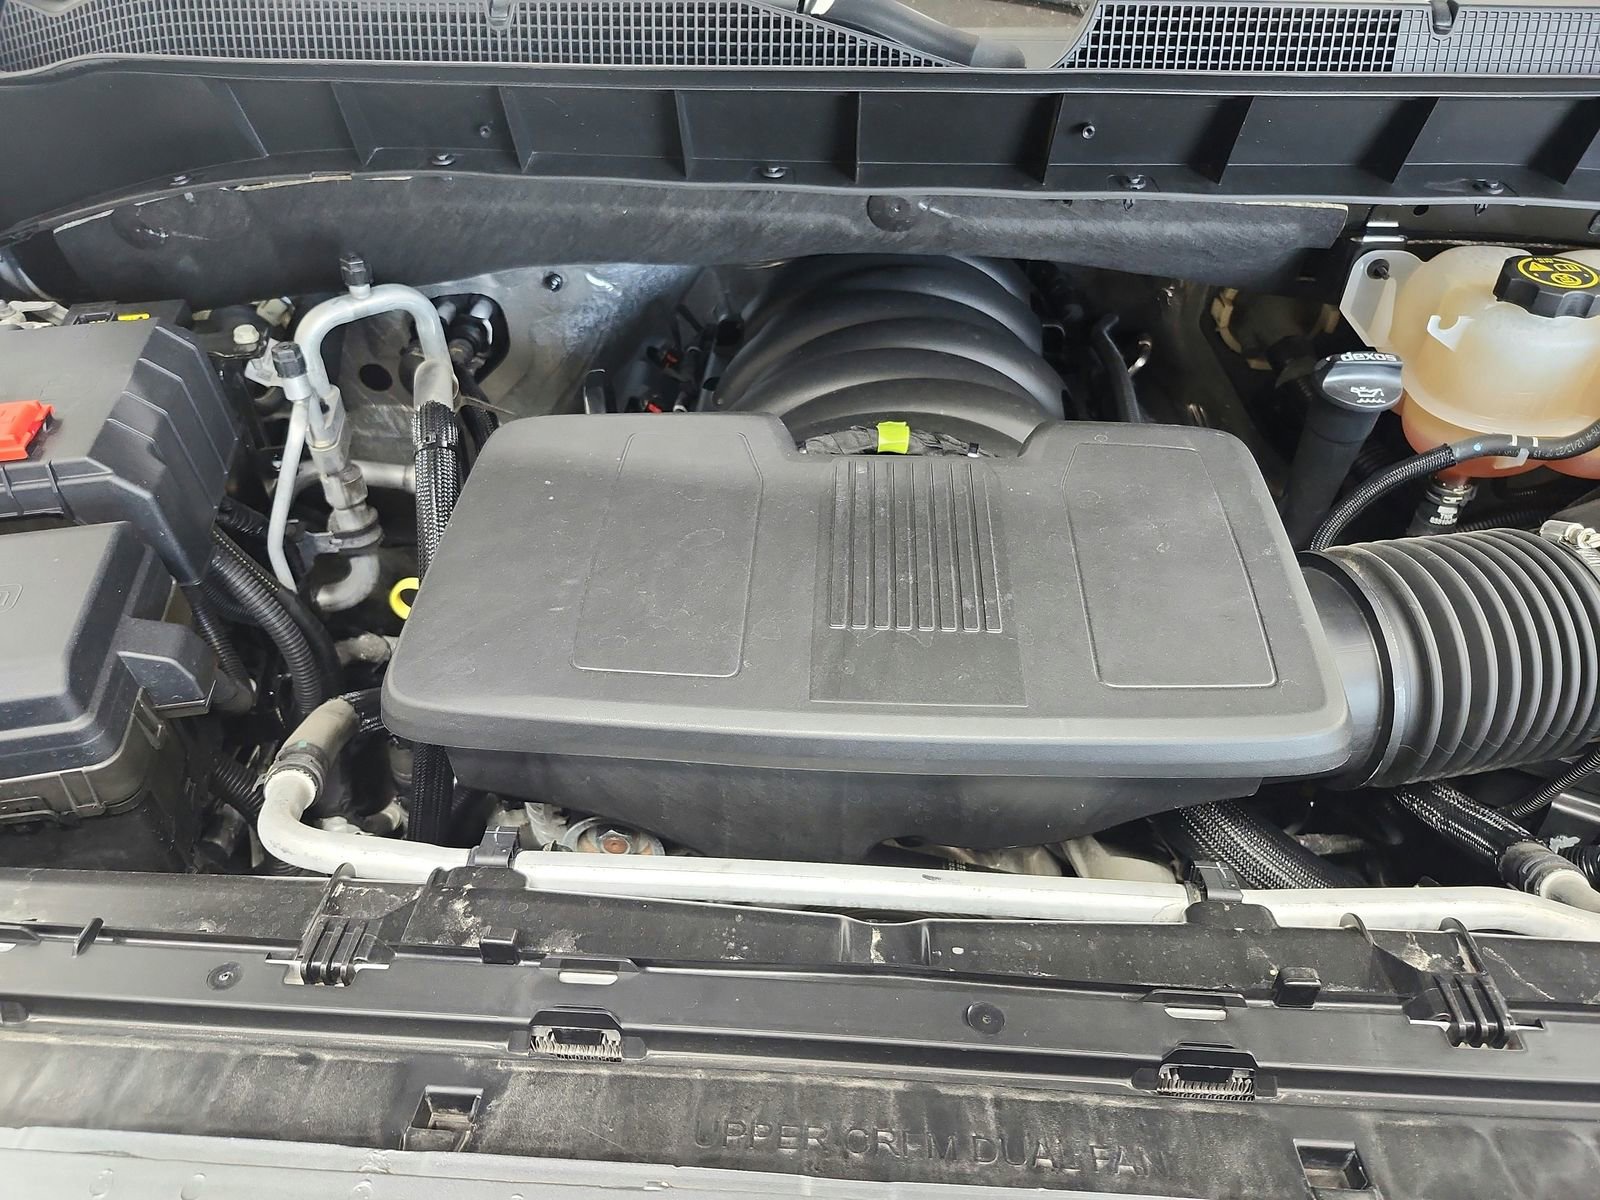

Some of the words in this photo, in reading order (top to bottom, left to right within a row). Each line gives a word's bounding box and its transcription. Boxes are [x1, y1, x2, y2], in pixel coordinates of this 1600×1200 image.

[1340, 352, 1397, 361] dexos
[695, 1118, 828, 1151] UPPER
[972, 1134, 1081, 1171] DUAL
[1089, 1143, 1170, 1177] FAN
